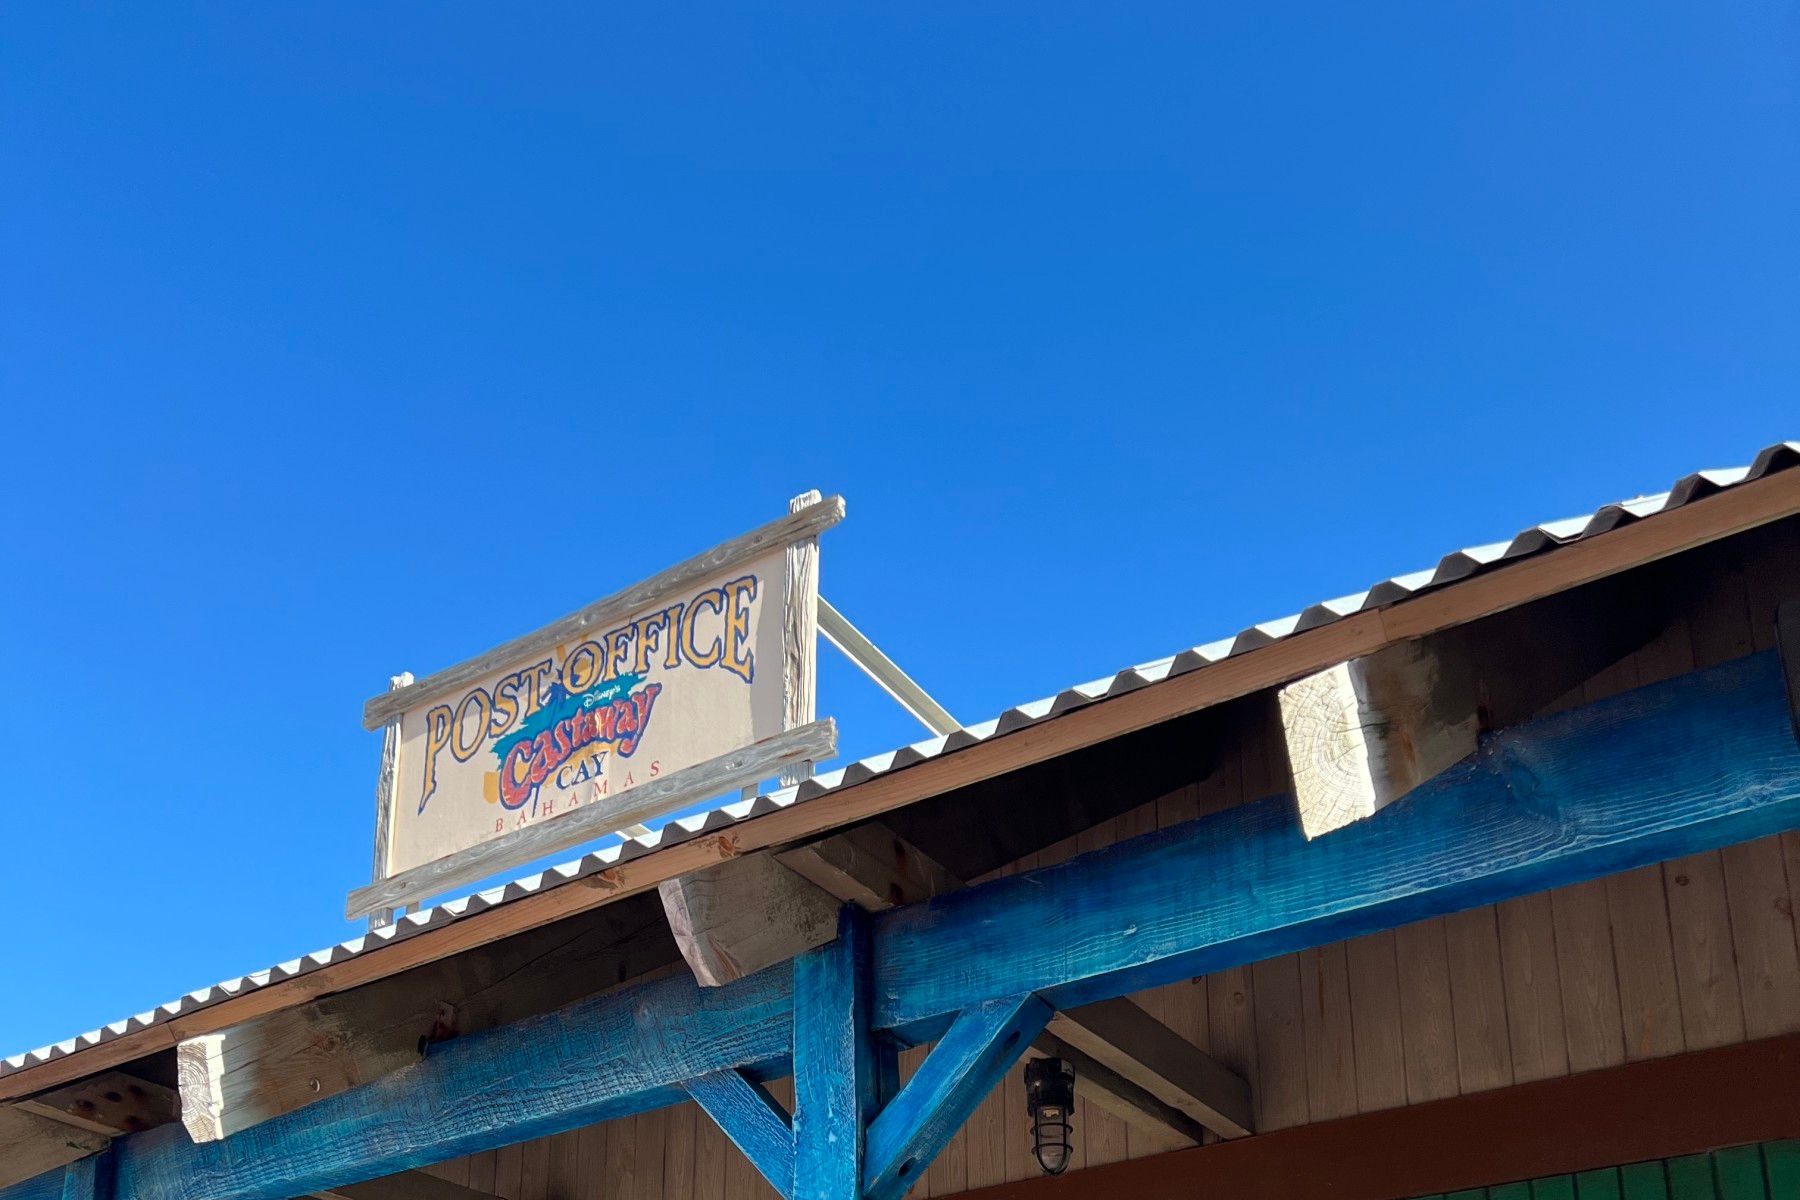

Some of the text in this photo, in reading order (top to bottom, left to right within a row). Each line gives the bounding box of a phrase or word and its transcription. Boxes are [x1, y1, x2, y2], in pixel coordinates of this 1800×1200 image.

[418, 574, 757, 815] POST OFFICE
[495, 760, 660, 833] BAHAMAS
[499, 682, 662, 815] Castaway
[556, 751, 609, 790] CAY
